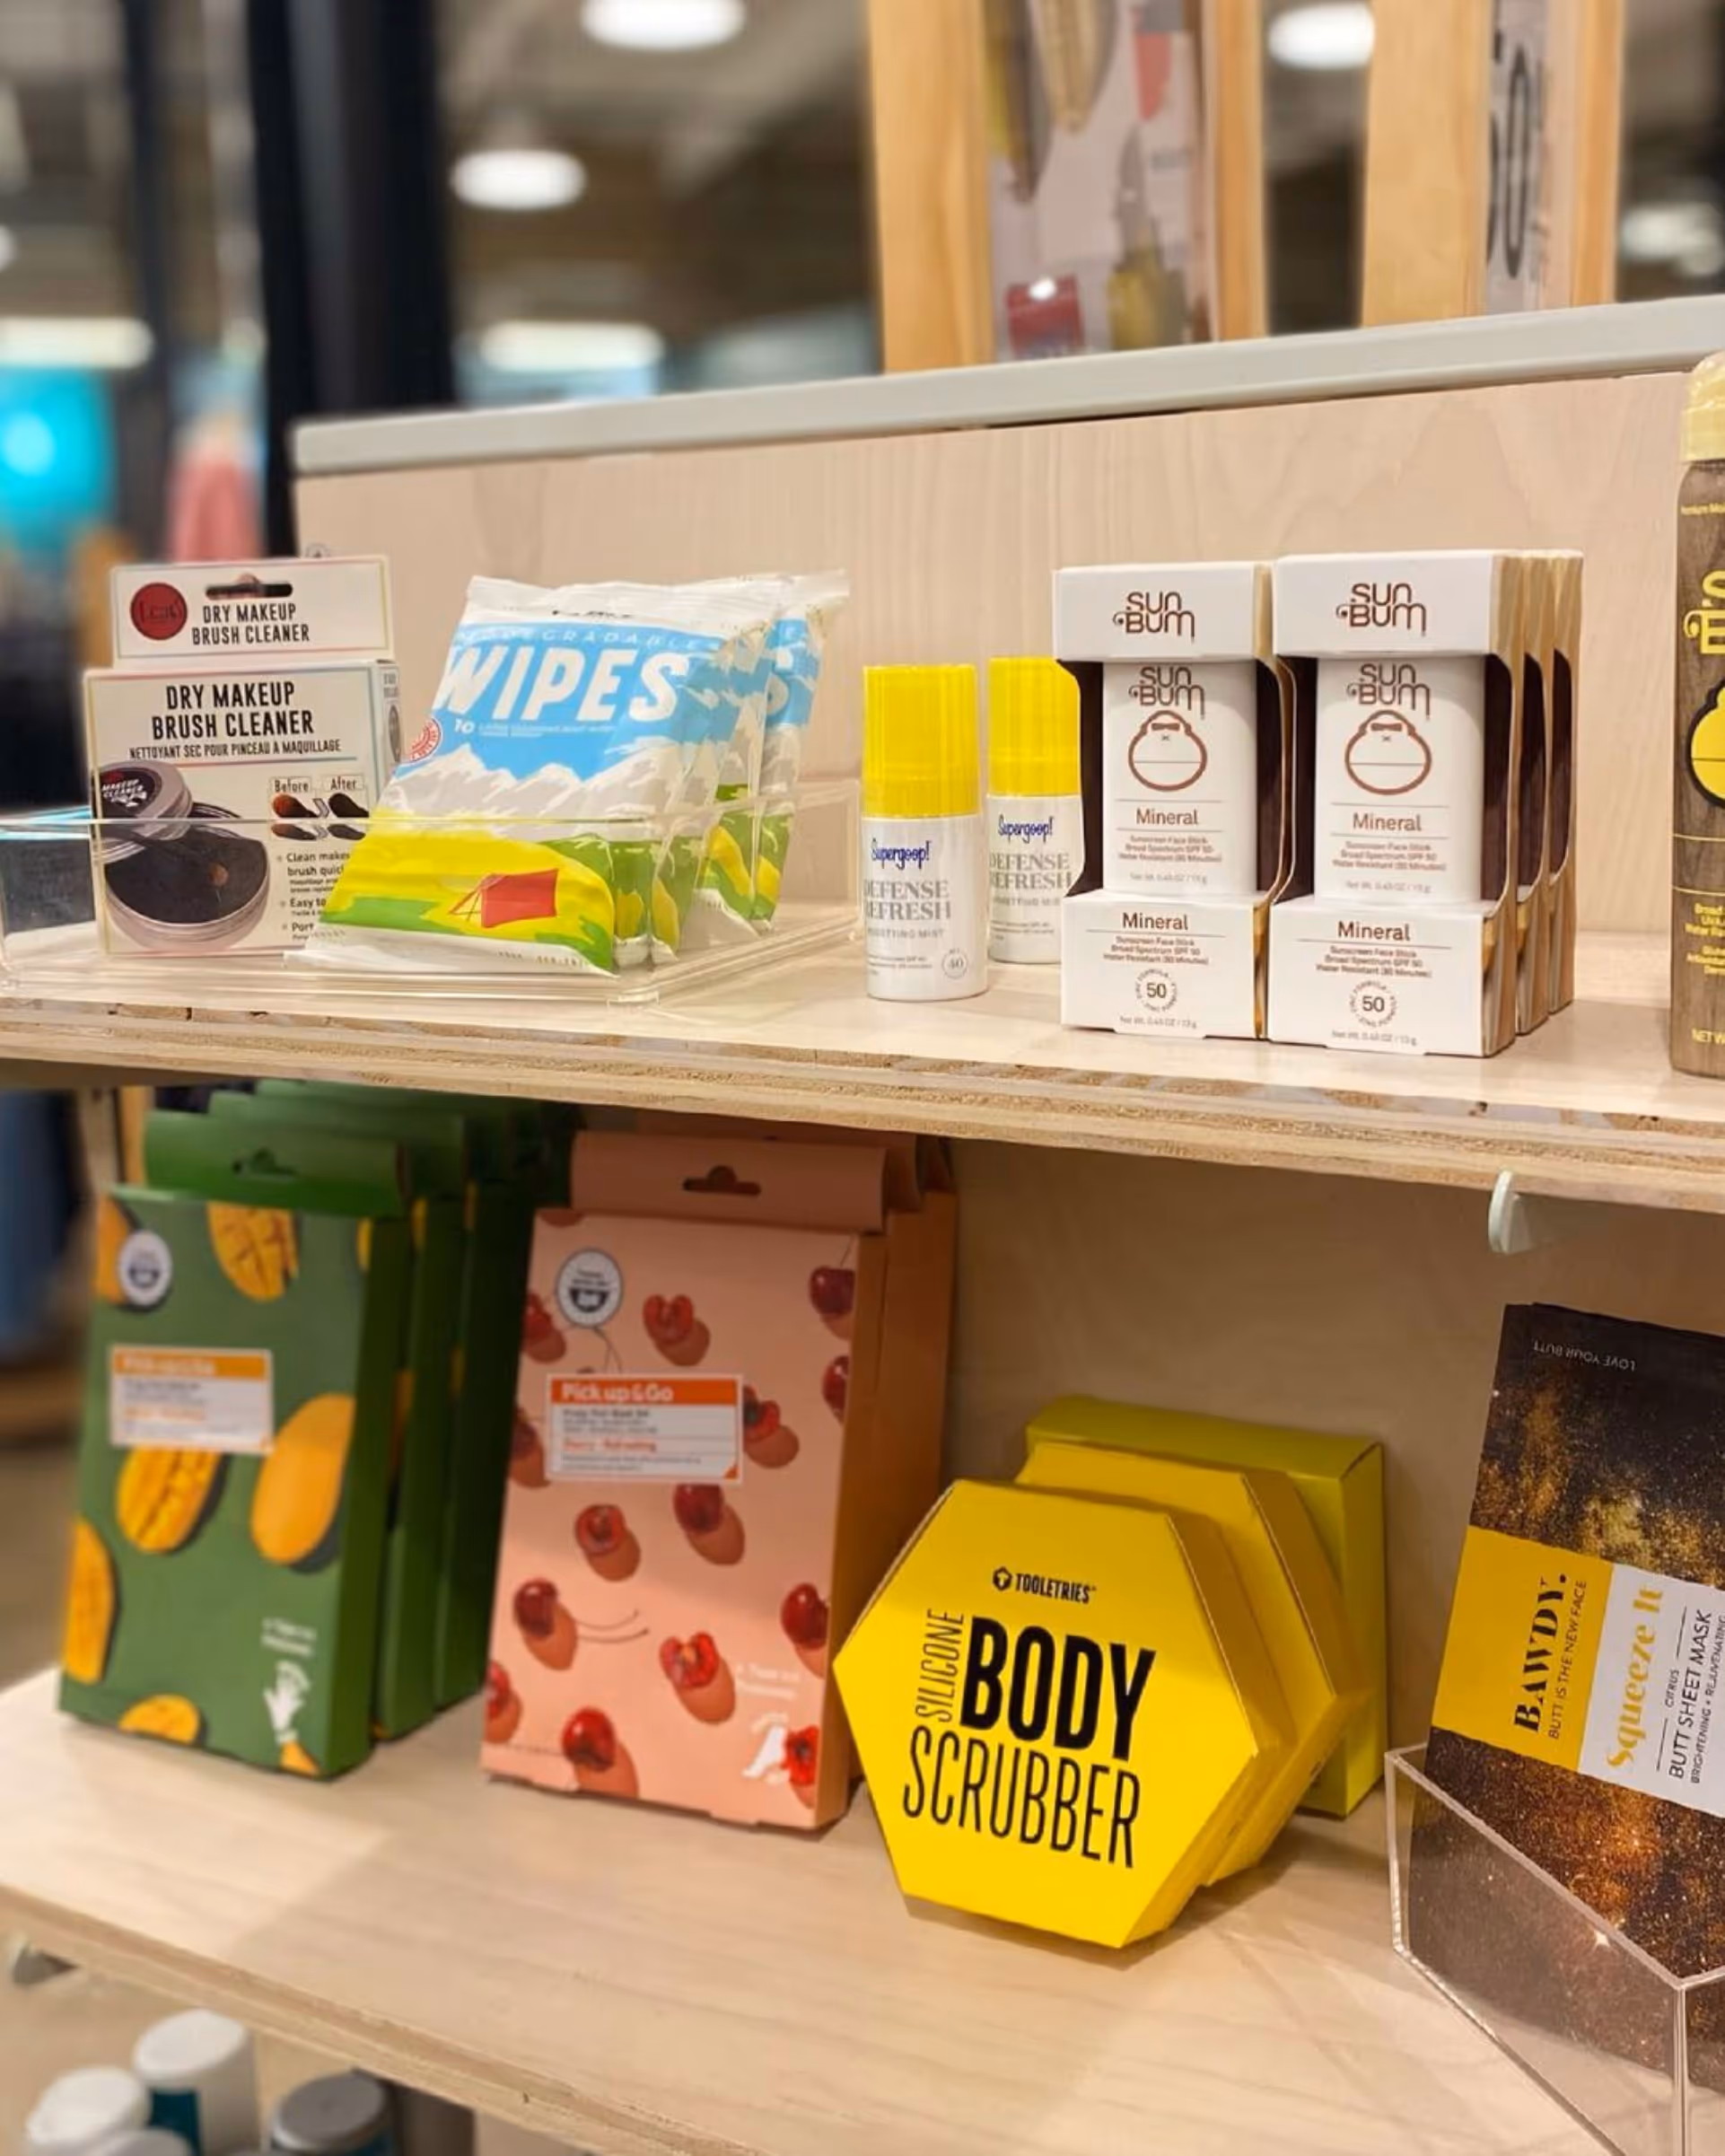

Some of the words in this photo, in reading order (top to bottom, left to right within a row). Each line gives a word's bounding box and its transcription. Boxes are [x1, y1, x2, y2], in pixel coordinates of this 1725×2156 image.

[203, 604, 231, 624] DRY
[236, 602, 296, 622] MAKEUP
[191, 626, 240, 645] BRUSH
[245, 624, 310, 644] CLEANER
[166, 684, 204, 709] DRY
[213, 680, 294, 708] MAKEUP
[432, 645, 689, 722] WIPES
[152, 714, 217, 741] BRUSH
[225, 709, 314, 738] CLEANER
[129, 746, 180, 759] NETTOYANT
[184, 744, 202, 758] SEC
[205, 743, 228, 758] POUR
[232, 742, 270, 756] PINCEAU
[283, 739, 342, 754] MAQUILLAGE
[274, 778, 309, 793] Before
[330, 776, 357, 790] After
[998, 814, 1054, 845] Supergoop!
[1136, 808, 1199, 825] Mineral
[1353, 813, 1422, 831] Mineral
[286, 853, 316, 863] Clean
[871, 837, 932, 870] Supergoop!
[287, 866, 317, 877] brush
[290, 898, 313, 909] Easy
[1122, 912, 1188, 931] Mineral
[1337, 921, 1410, 941] Mineral
[1147, 982, 1167, 998] 50
[1362, 995, 1386, 1012] 50
[1534, 1340, 1563, 1357] BUTT
[1565, 1346, 1598, 1364] YOUR
[1603, 1354, 1635, 1372] LOVE
[1571, 1580, 1587, 1616] FACE
[1563, 1620, 1580, 1653] NEW
[1689, 1608, 1712, 1667] MASK
[915, 1608, 965, 1723] SILICONE
[1514, 1573, 1567, 1732] BAWDY.
[1558, 1656, 1572, 1683] THE
[1607, 1624, 1656, 1767] Squeeze
[1633, 1586, 1663, 1613] It
[959, 1616, 1158, 1762] BODY
[1555, 1688, 1567, 1700] IS
[1665, 1670, 1680, 1708] CITRUS
[1677, 1667, 1702, 1729] SHEET
[1547, 1705, 1563, 1740] BUTT
[1668, 1731, 1687, 1780] BUTT
[1690, 1709, 1712, 1784] BRIGHTENING
[903, 1724, 1141, 1869] SCRUBBER
